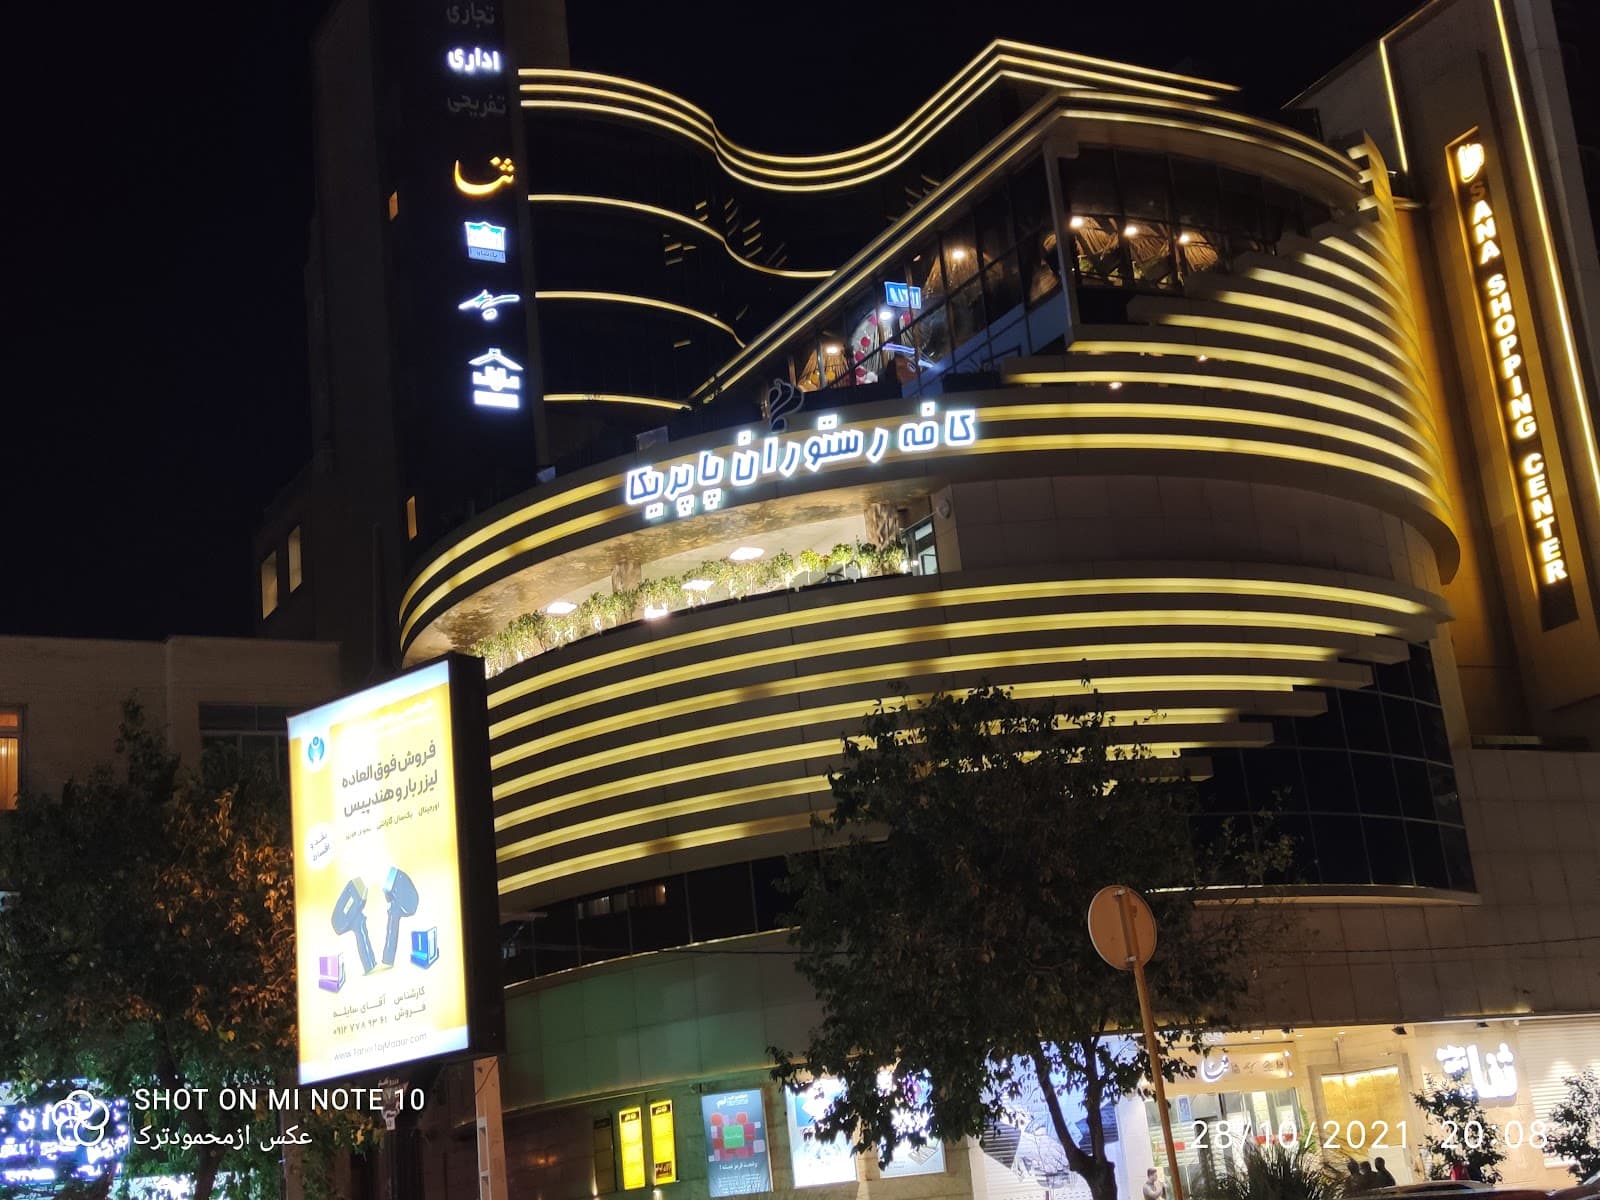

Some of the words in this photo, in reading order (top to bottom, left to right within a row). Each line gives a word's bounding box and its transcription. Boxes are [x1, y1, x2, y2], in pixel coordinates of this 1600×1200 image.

[446, 2, 495, 28] تجاری
[446, 46, 502, 74] اداری
[898, 401, 976, 452] کافه
[1487, 273, 1537, 440] SHOPPING
[1521, 452, 1568, 585] CENTER
[730, 414, 889, 486] رستوران
[625, 450, 725, 520] پاپریکا
[373, 754, 397, 781] فوق
[398, 739, 436, 772] فروش
[342, 764, 373, 788] العاده
[403, 777, 417, 800] بار
[417, 769, 438, 795] لیزر
[394, 986, 425, 1005] کارشناس
[395, 1003, 426, 1021] فروش
